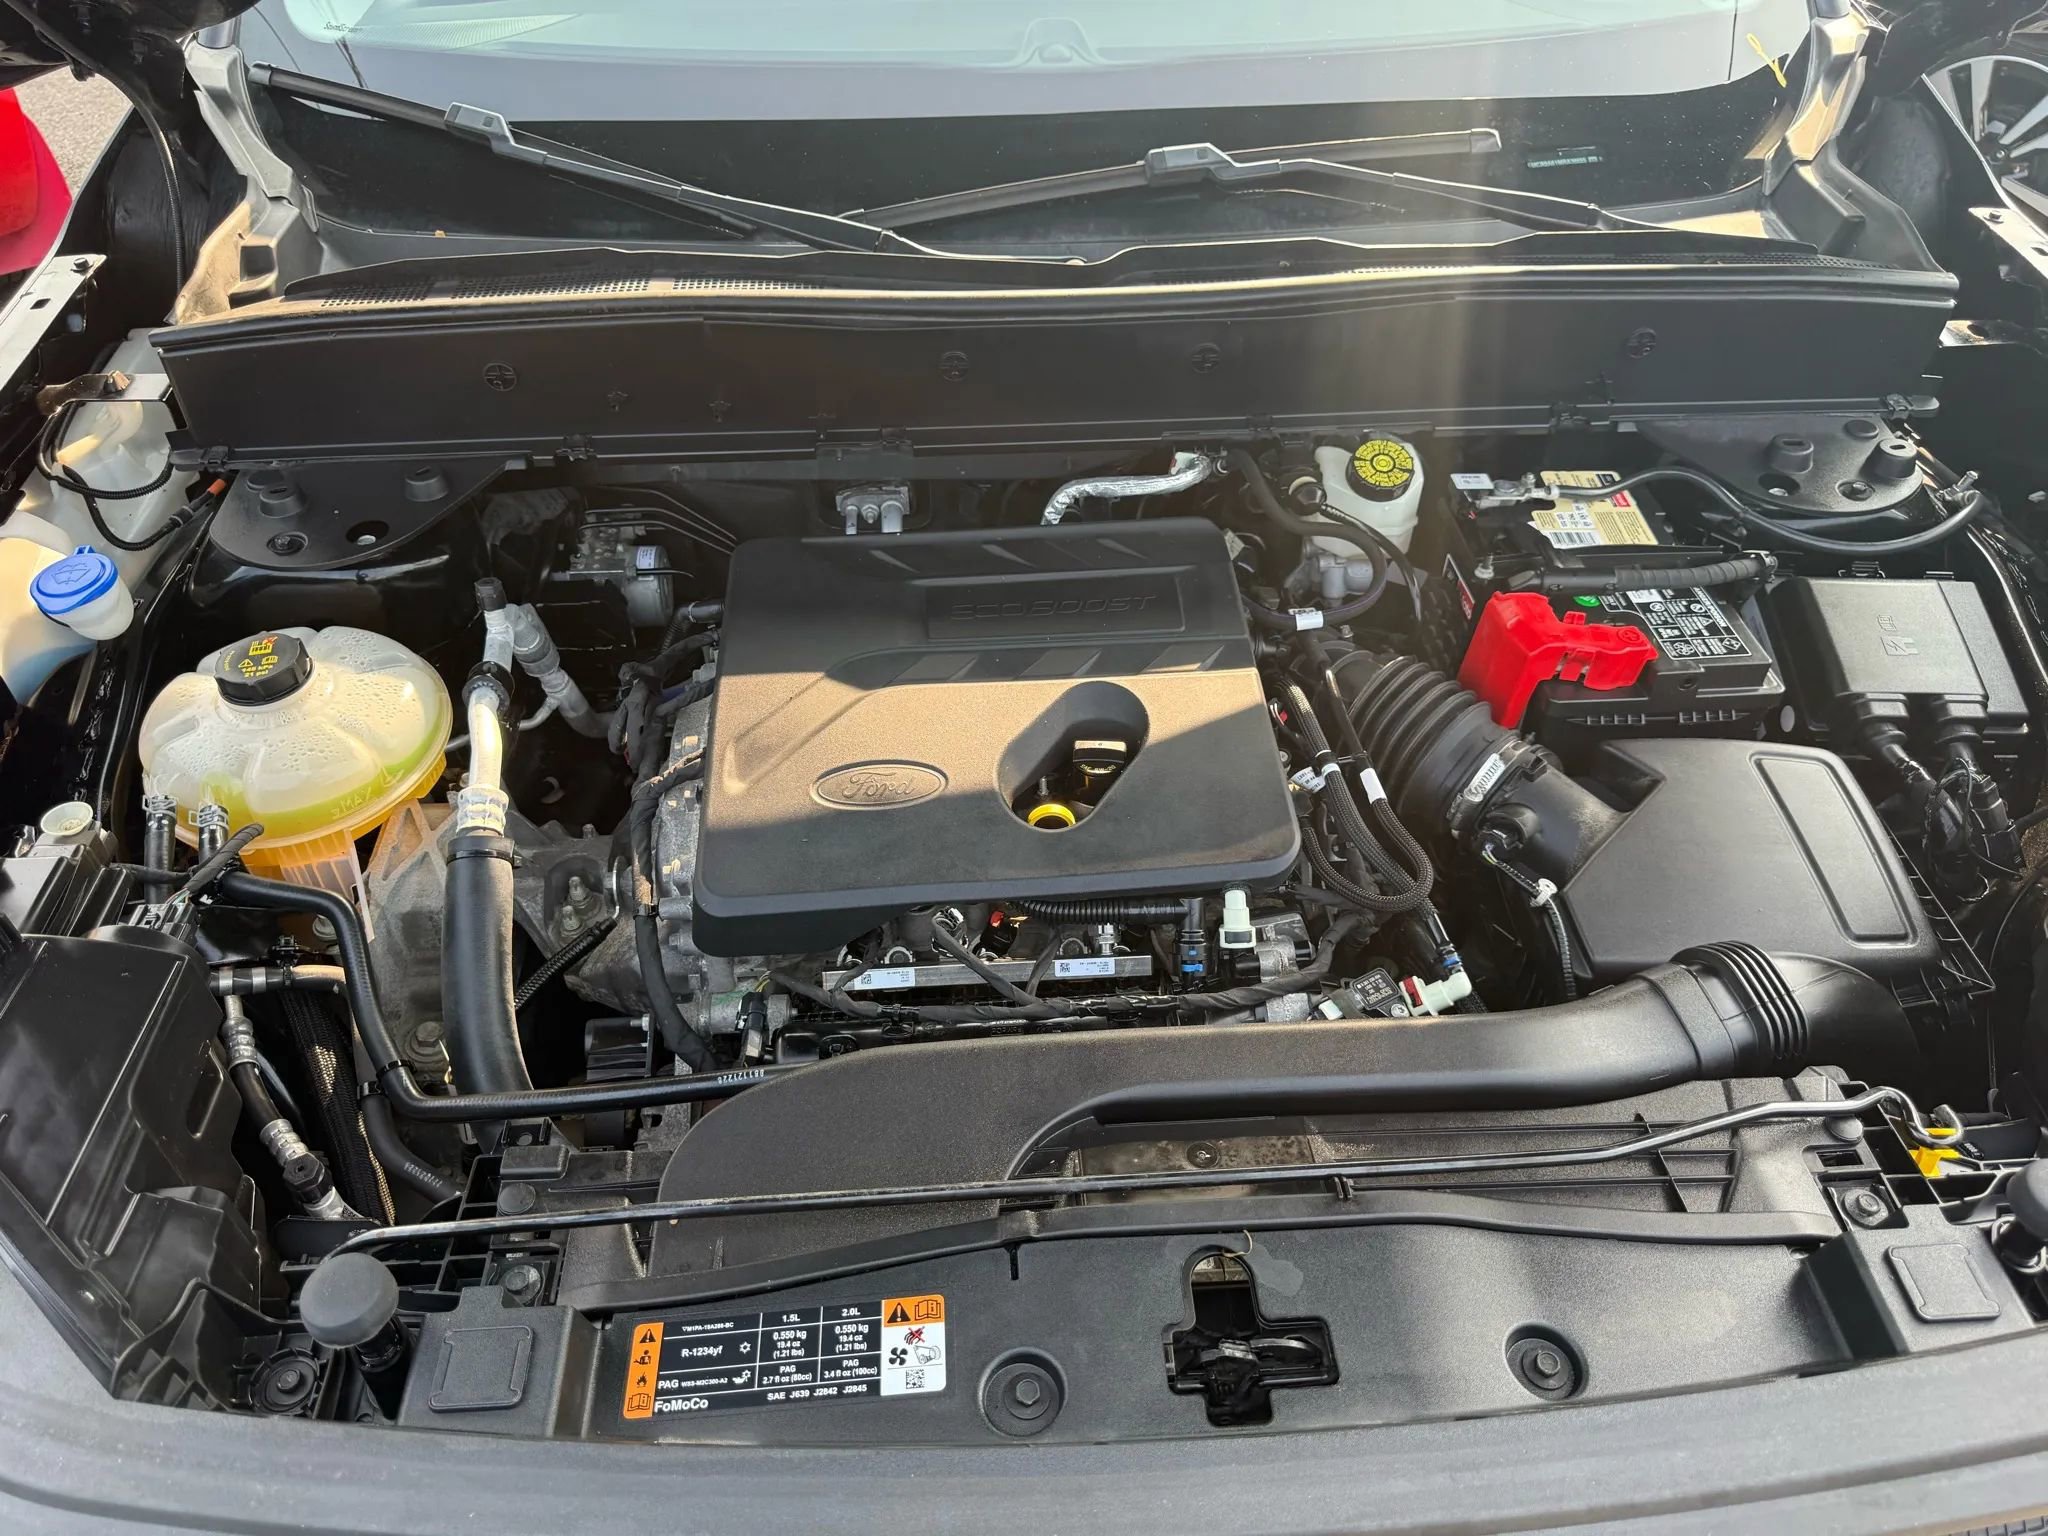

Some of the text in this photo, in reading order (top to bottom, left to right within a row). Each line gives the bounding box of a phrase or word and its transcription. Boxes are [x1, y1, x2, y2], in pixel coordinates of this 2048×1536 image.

[841, 771, 919, 799] Ford
[782, 1313, 800, 1322] 1.5L
[842, 1307, 860, 1317] 2.0L
[834, 1323, 869, 1334] 0.550 kg
[773, 1330, 807, 1341] 0.550 kg
[839, 1335, 853, 1343] 19.4
[777, 1341, 791, 1349] 19.4
[835, 1342, 867, 1353] (1.21 lbs)
[681, 1345, 723, 1358] R-1234yf
[773, 1348, 805, 1359] (1.21 lbs)
[842, 1359, 859, 1368] PAG
[780, 1365, 796, 1374] PAG
[824, 1370, 835, 1379] 3.4
[852, 1367, 878, 1377] (100cc)
[658, 1380, 679, 1390] PAG
[762, 1376, 774, 1385] 2.7
[767, 1384, 868, 1401] SAE J639 J2842 J2845
[654, 1397, 709, 1413] FoMoCo
